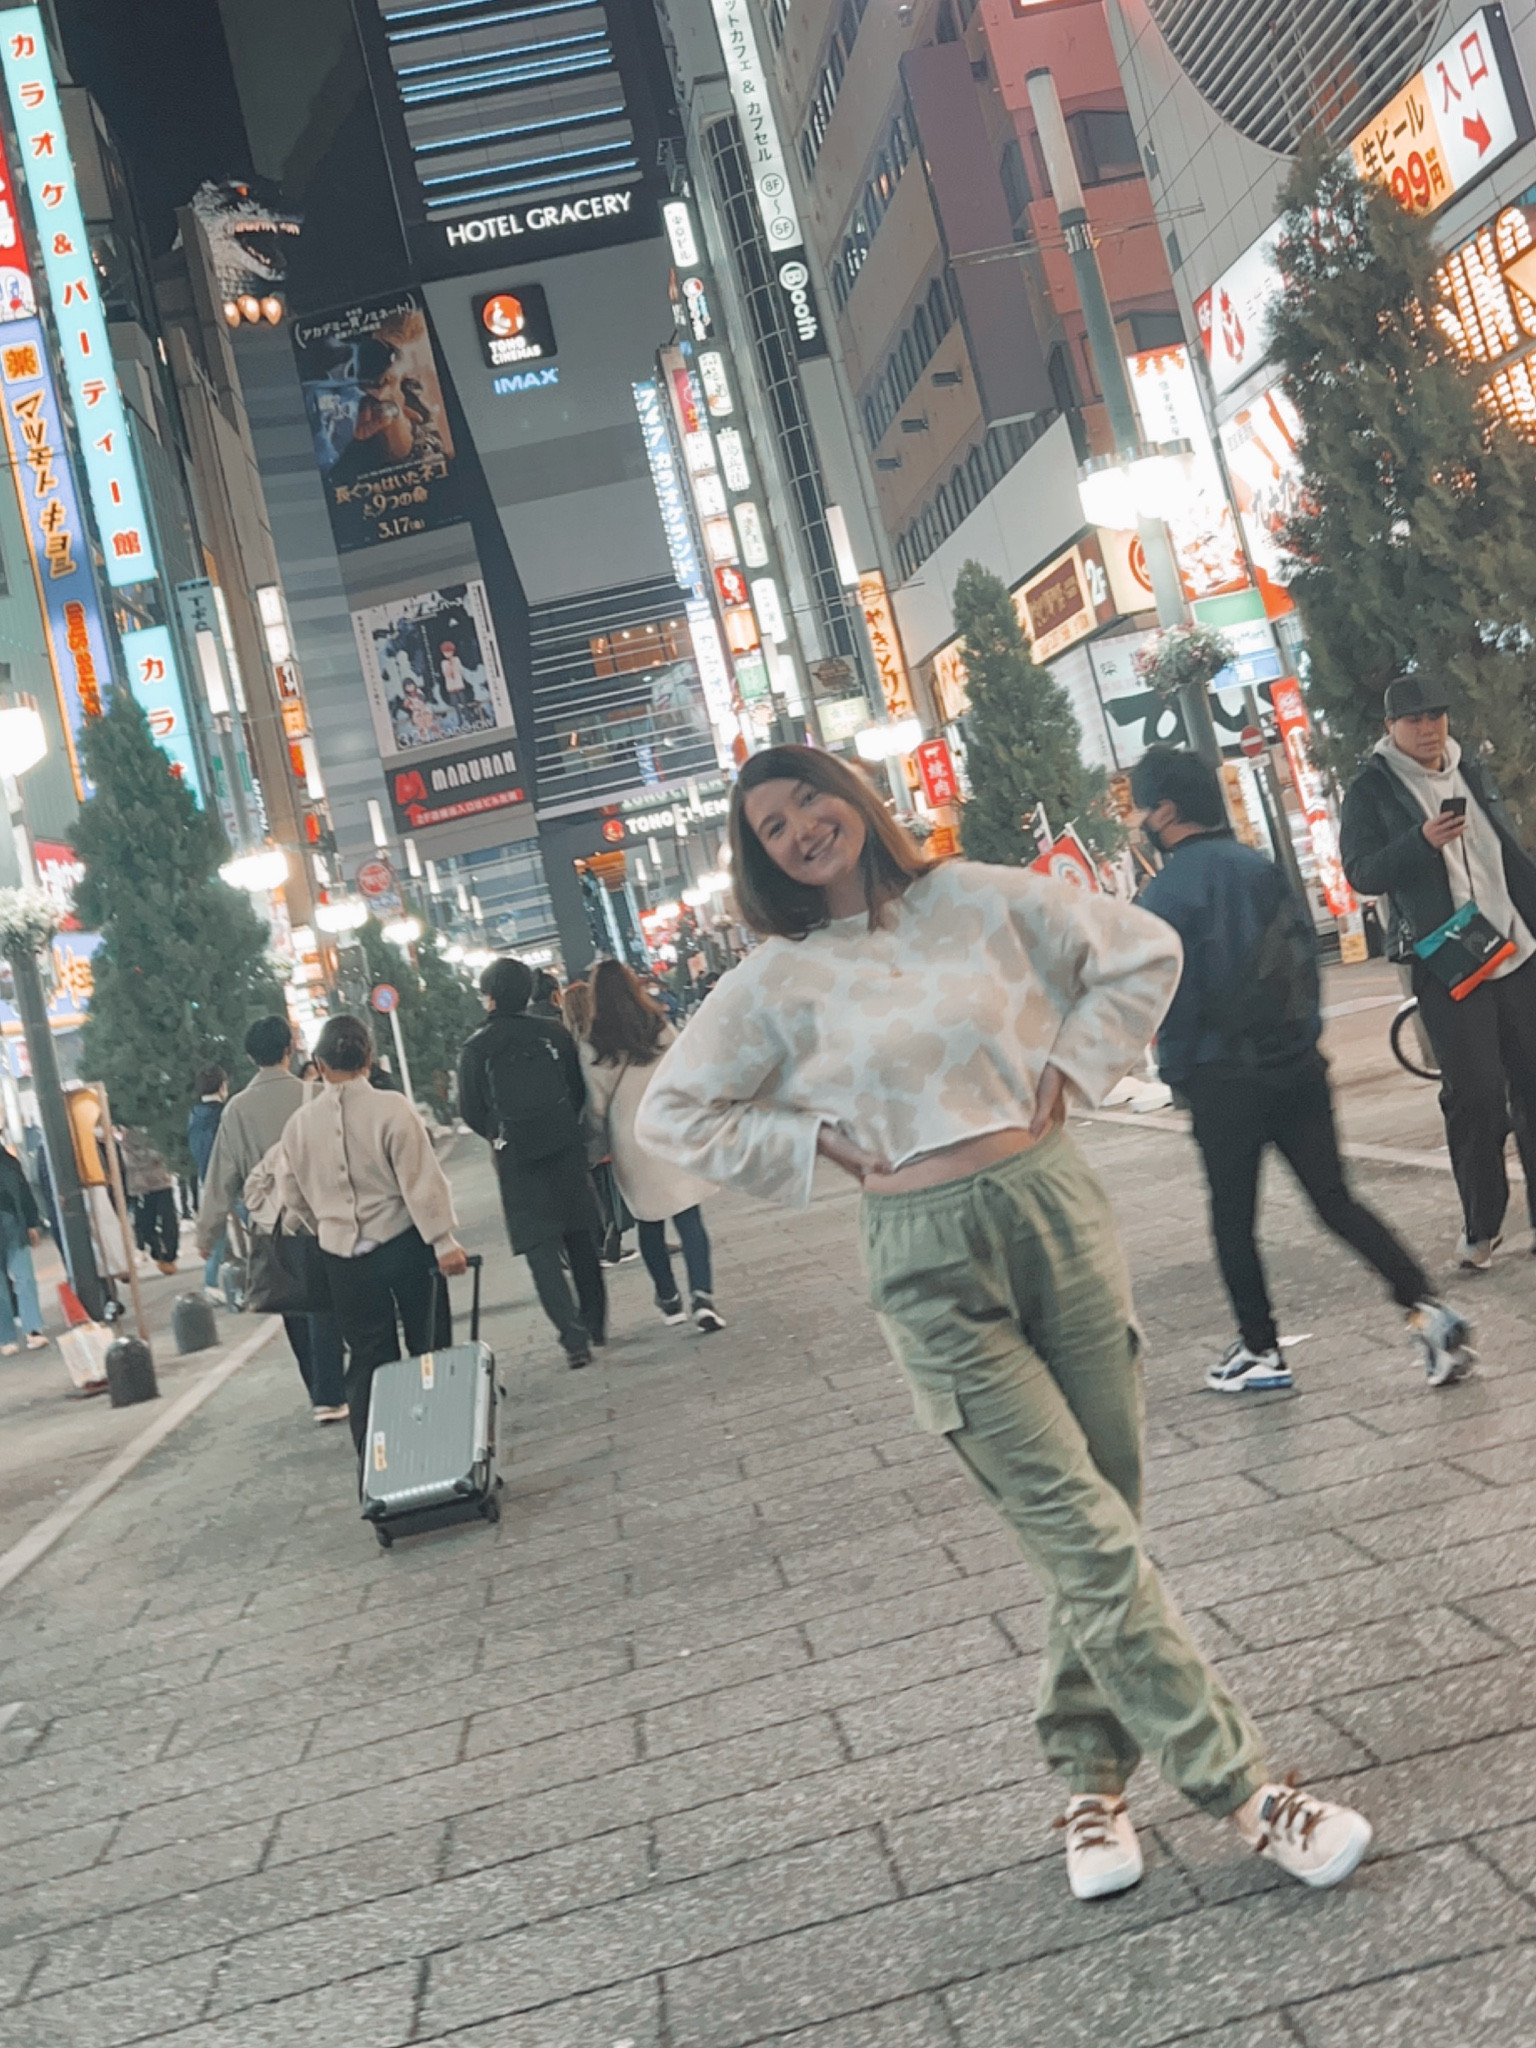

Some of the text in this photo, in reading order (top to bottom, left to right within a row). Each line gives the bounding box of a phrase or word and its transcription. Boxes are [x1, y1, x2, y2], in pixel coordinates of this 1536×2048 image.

[1436, 30, 1489, 113] 入口
[1361, 94, 1423, 180] 生ビール
[445, 191, 632, 248] HOTEL GRACERY
[779, 261, 818, 341] Booth
[491, 344, 542, 365] CINEMAS
[494, 368, 558, 394] IMAX
[639, 387, 668, 445] 747
[13, 390, 76, 578] マツモトキヨシ
[431, 750, 516, 791] MARUHAN
[625, 810, 674, 834] TOHO
